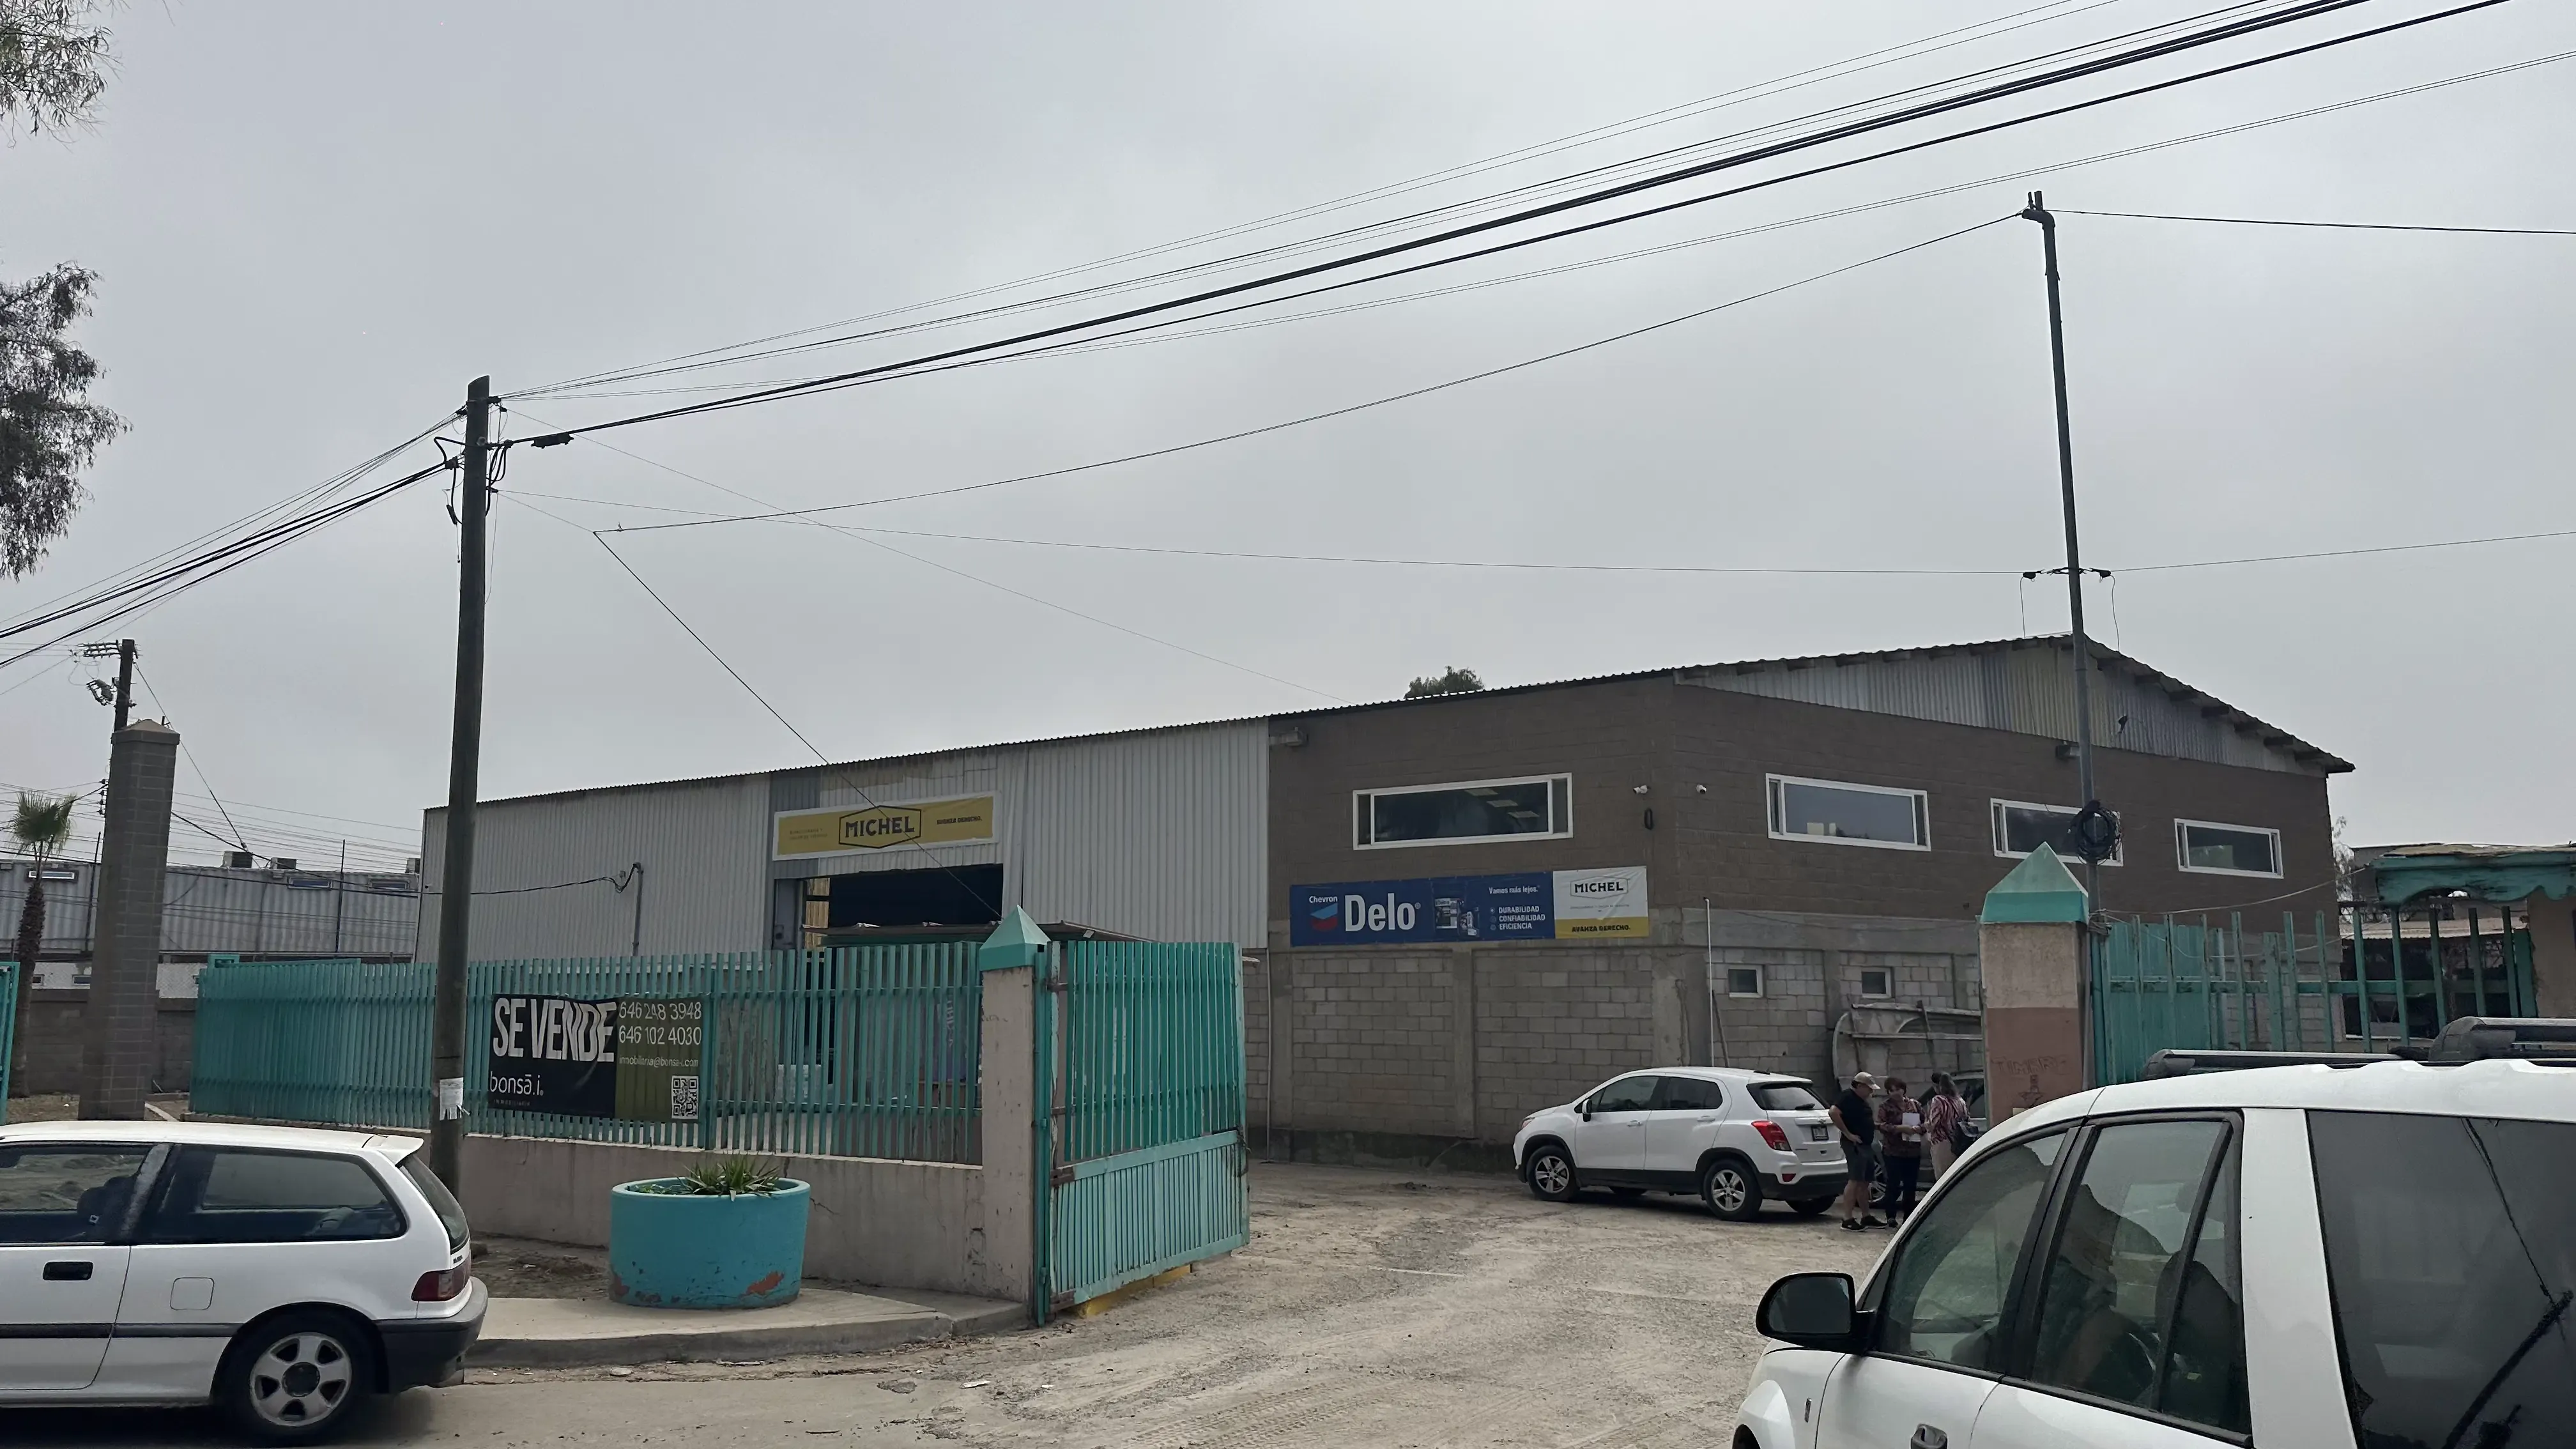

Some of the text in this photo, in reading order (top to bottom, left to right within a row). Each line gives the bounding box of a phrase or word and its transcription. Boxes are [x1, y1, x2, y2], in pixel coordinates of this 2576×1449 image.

[845, 815, 915, 838] MICHEL
[1574, 882, 1624, 893] MICHEL
[1309, 895, 1338, 903] Chevron
[1498, 905, 1540, 914] DURABILIDAD
[1498, 914, 1545, 922] CONFIABILIDAD
[1499, 922, 1533, 930] EFICIENCIA
[618, 1001, 702, 1020] 646 248 3948
[493, 997, 617, 1062] SE VENDE
[618, 1025, 702, 1045] 646 102 4030
